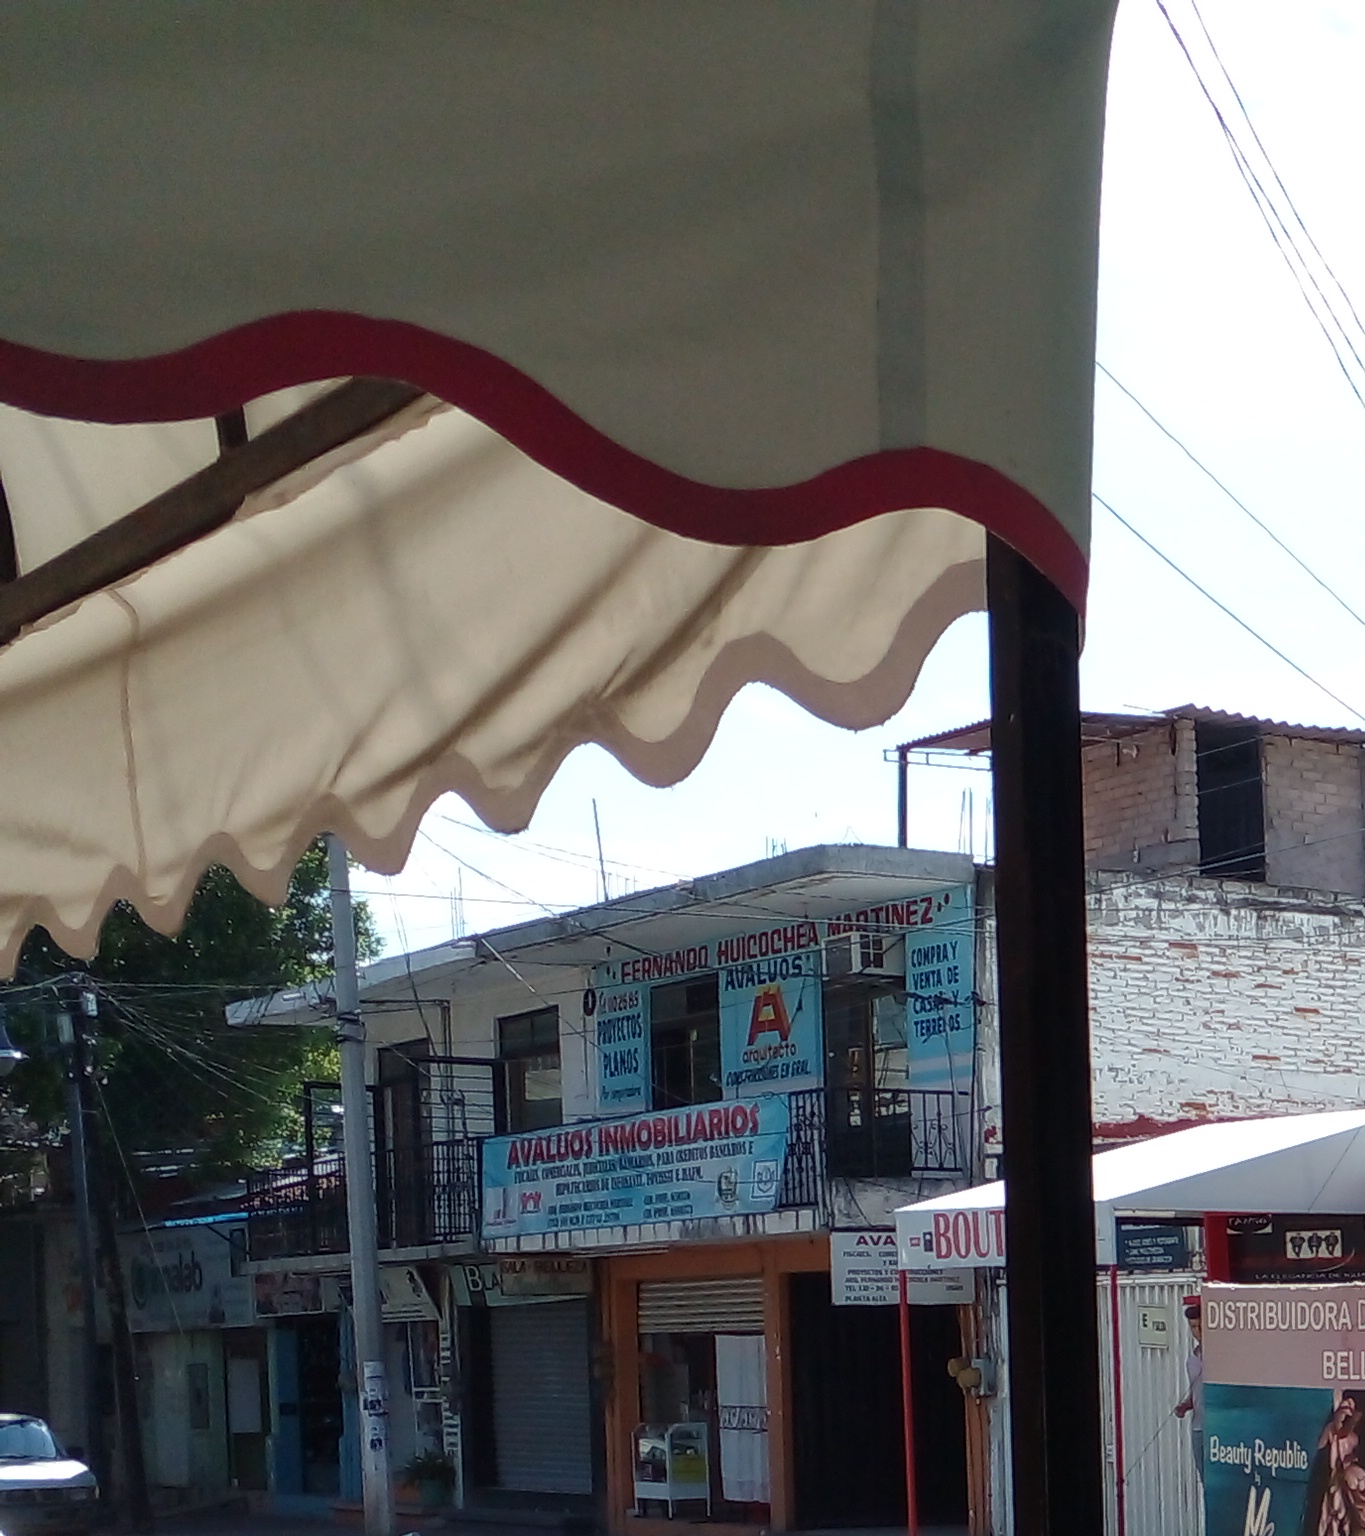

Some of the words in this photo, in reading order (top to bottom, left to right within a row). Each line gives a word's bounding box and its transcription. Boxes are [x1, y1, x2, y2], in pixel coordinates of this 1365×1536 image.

[621, 945, 709, 984] FERNANDO
[716, 919, 820, 966] HUICOCHEA
[827, 896, 934, 939] MARTINEZ
[911, 942, 948, 968] COMPRA
[725, 955, 803, 992] AVALUOS
[911, 969, 943, 994] VENTA
[947, 966, 960, 985] DE
[603, 1047, 640, 1079] PLANOS
[507, 1130, 593, 1169] AVALUOS
[598, 1102, 760, 1157] INMOBILIARIOS
[1207, 1300, 1352, 1331] DISTRIBUIDORA
[1210, 1435, 1252, 1474] Beauty
[1254, 1437, 1309, 1477] Republic
